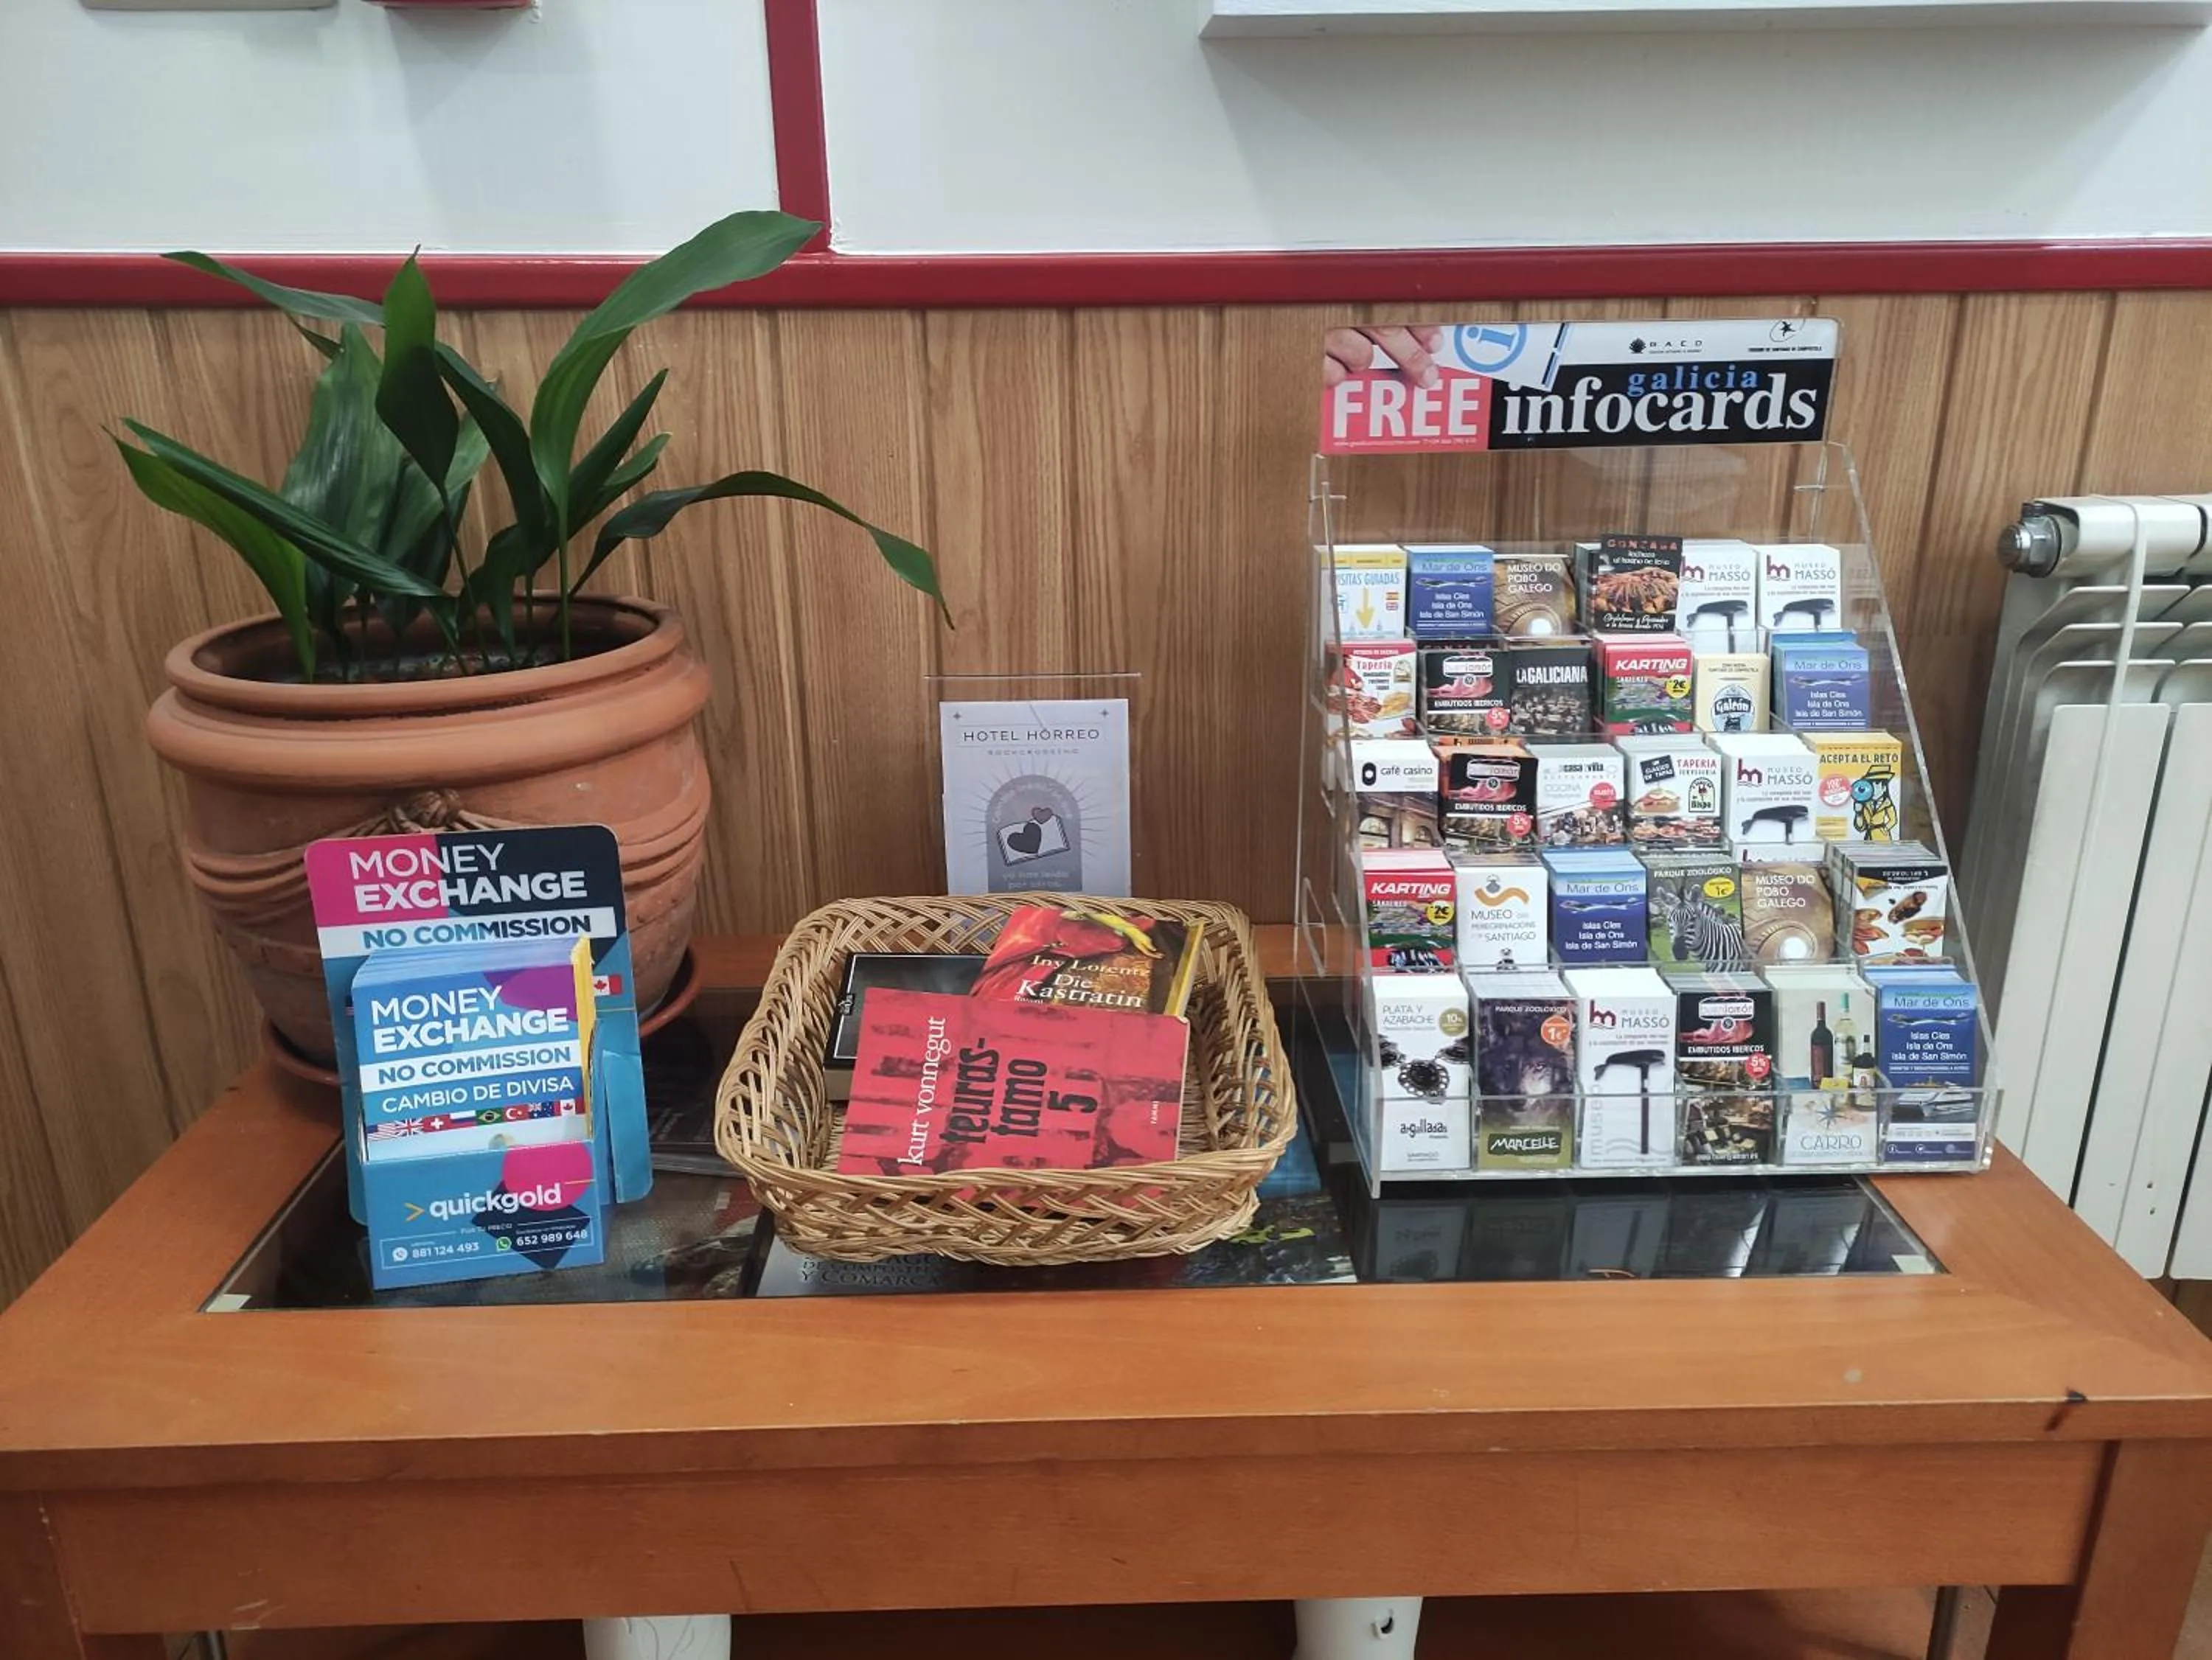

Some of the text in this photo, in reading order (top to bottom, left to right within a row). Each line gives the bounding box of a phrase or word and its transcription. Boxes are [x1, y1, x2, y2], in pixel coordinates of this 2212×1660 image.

[1627, 365, 1759, 396] galicia
[1333, 379, 1479, 439] FREE
[1501, 373, 1818, 435] infocards
[1507, 562, 1543, 573] MUSEO
[1508, 583, 1552, 594] GALEGO
[1615, 658, 1688, 672] KARTING
[963, 730, 1019, 742] HOTEL
[1874, 753, 1899, 763] RETO
[1380, 764, 1433, 776] café casino
[349, 843, 504, 880] MONEY
[1756, 875, 1815, 885] MUSEO DO
[354, 871, 588, 913] EXCHANGE
[1371, 882, 1452, 896] KARTING
[1567, 883, 1639, 893] Mar de Ons
[1756, 886, 1790, 897] POBO
[1757, 897, 1806, 908] GALEGO
[1471, 909, 1513, 921] MUSEO
[363, 915, 592, 950] NO COMMISSION
[1485, 931, 1537, 941] SANTIAGO
[1054, 974, 1093, 988] Die
[1016, 979, 1143, 1008] Kastratin
[371, 985, 503, 1025] MONEY
[1383, 1005, 1422, 1015] PLATA Y
[1893, 997, 1970, 1008] Mar de Ons
[373, 1008, 569, 1053] EXCHANGE
[1935, 1042, 1953, 1050] Ons
[1921, 1052, 1938, 1061] San
[378, 1047, 571, 1086] NO COMMISSION
[382, 1075, 575, 1114] CAMBIO DE DIVISA
[897, 1016, 953, 1166] kurt vonnegut
[991, 1058, 1048, 1137] tamo
[1047, 1090, 1099, 1115] 5
[1489, 1135, 1560, 1151] MARCELLE
[1800, 1134, 1863, 1151] CARRO
[430, 1183, 562, 1221] quickgold
[517, 1235, 538, 1247] 652
[540, 1232, 563, 1244] 989
[412, 1241, 479, 1259] 881 124 493
[801, 1270, 941, 1286] Y COMARCA
